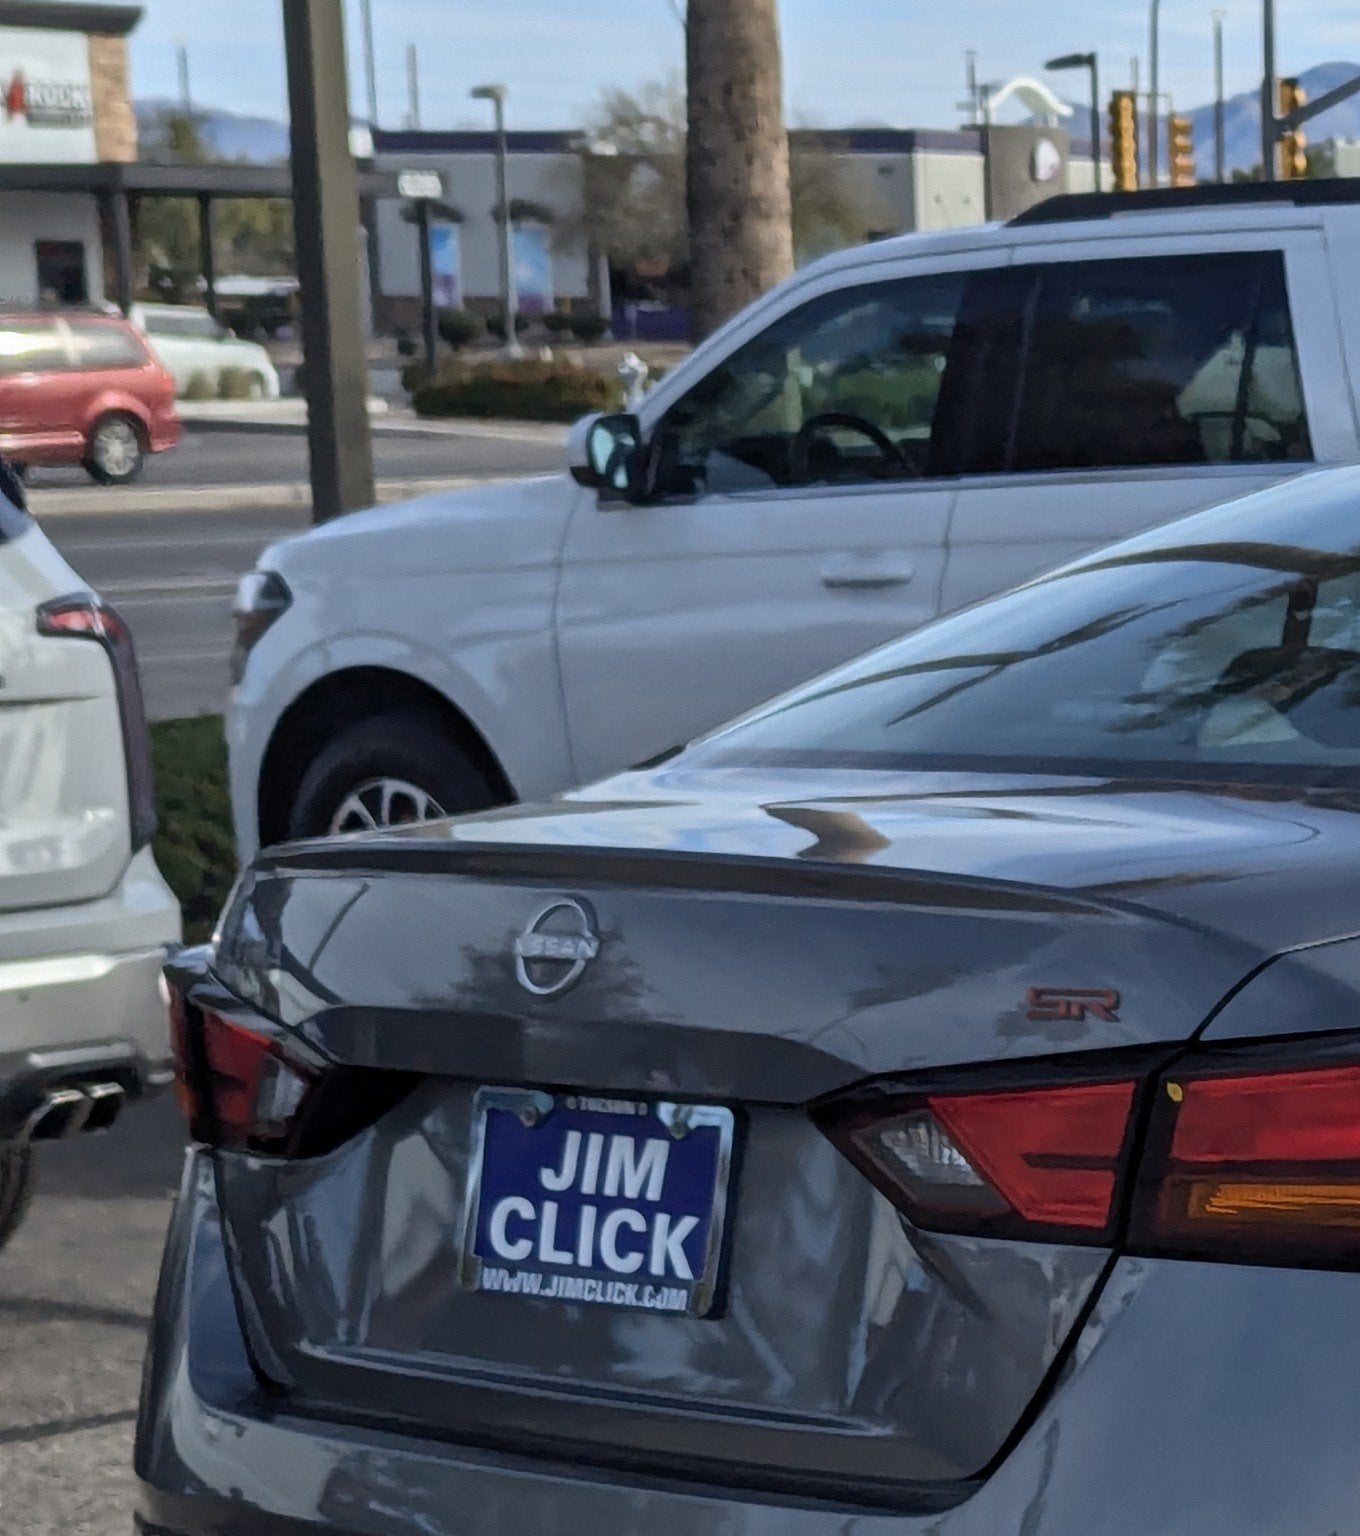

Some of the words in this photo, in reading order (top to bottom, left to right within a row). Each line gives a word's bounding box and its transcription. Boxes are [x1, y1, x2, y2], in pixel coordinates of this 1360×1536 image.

[1025, 986, 1121, 1023] SR
[539, 1130, 670, 1201] JIM
[489, 1196, 700, 1280] CLICK
[482, 1266, 689, 1311] WWW.JIMCLICK.COM
